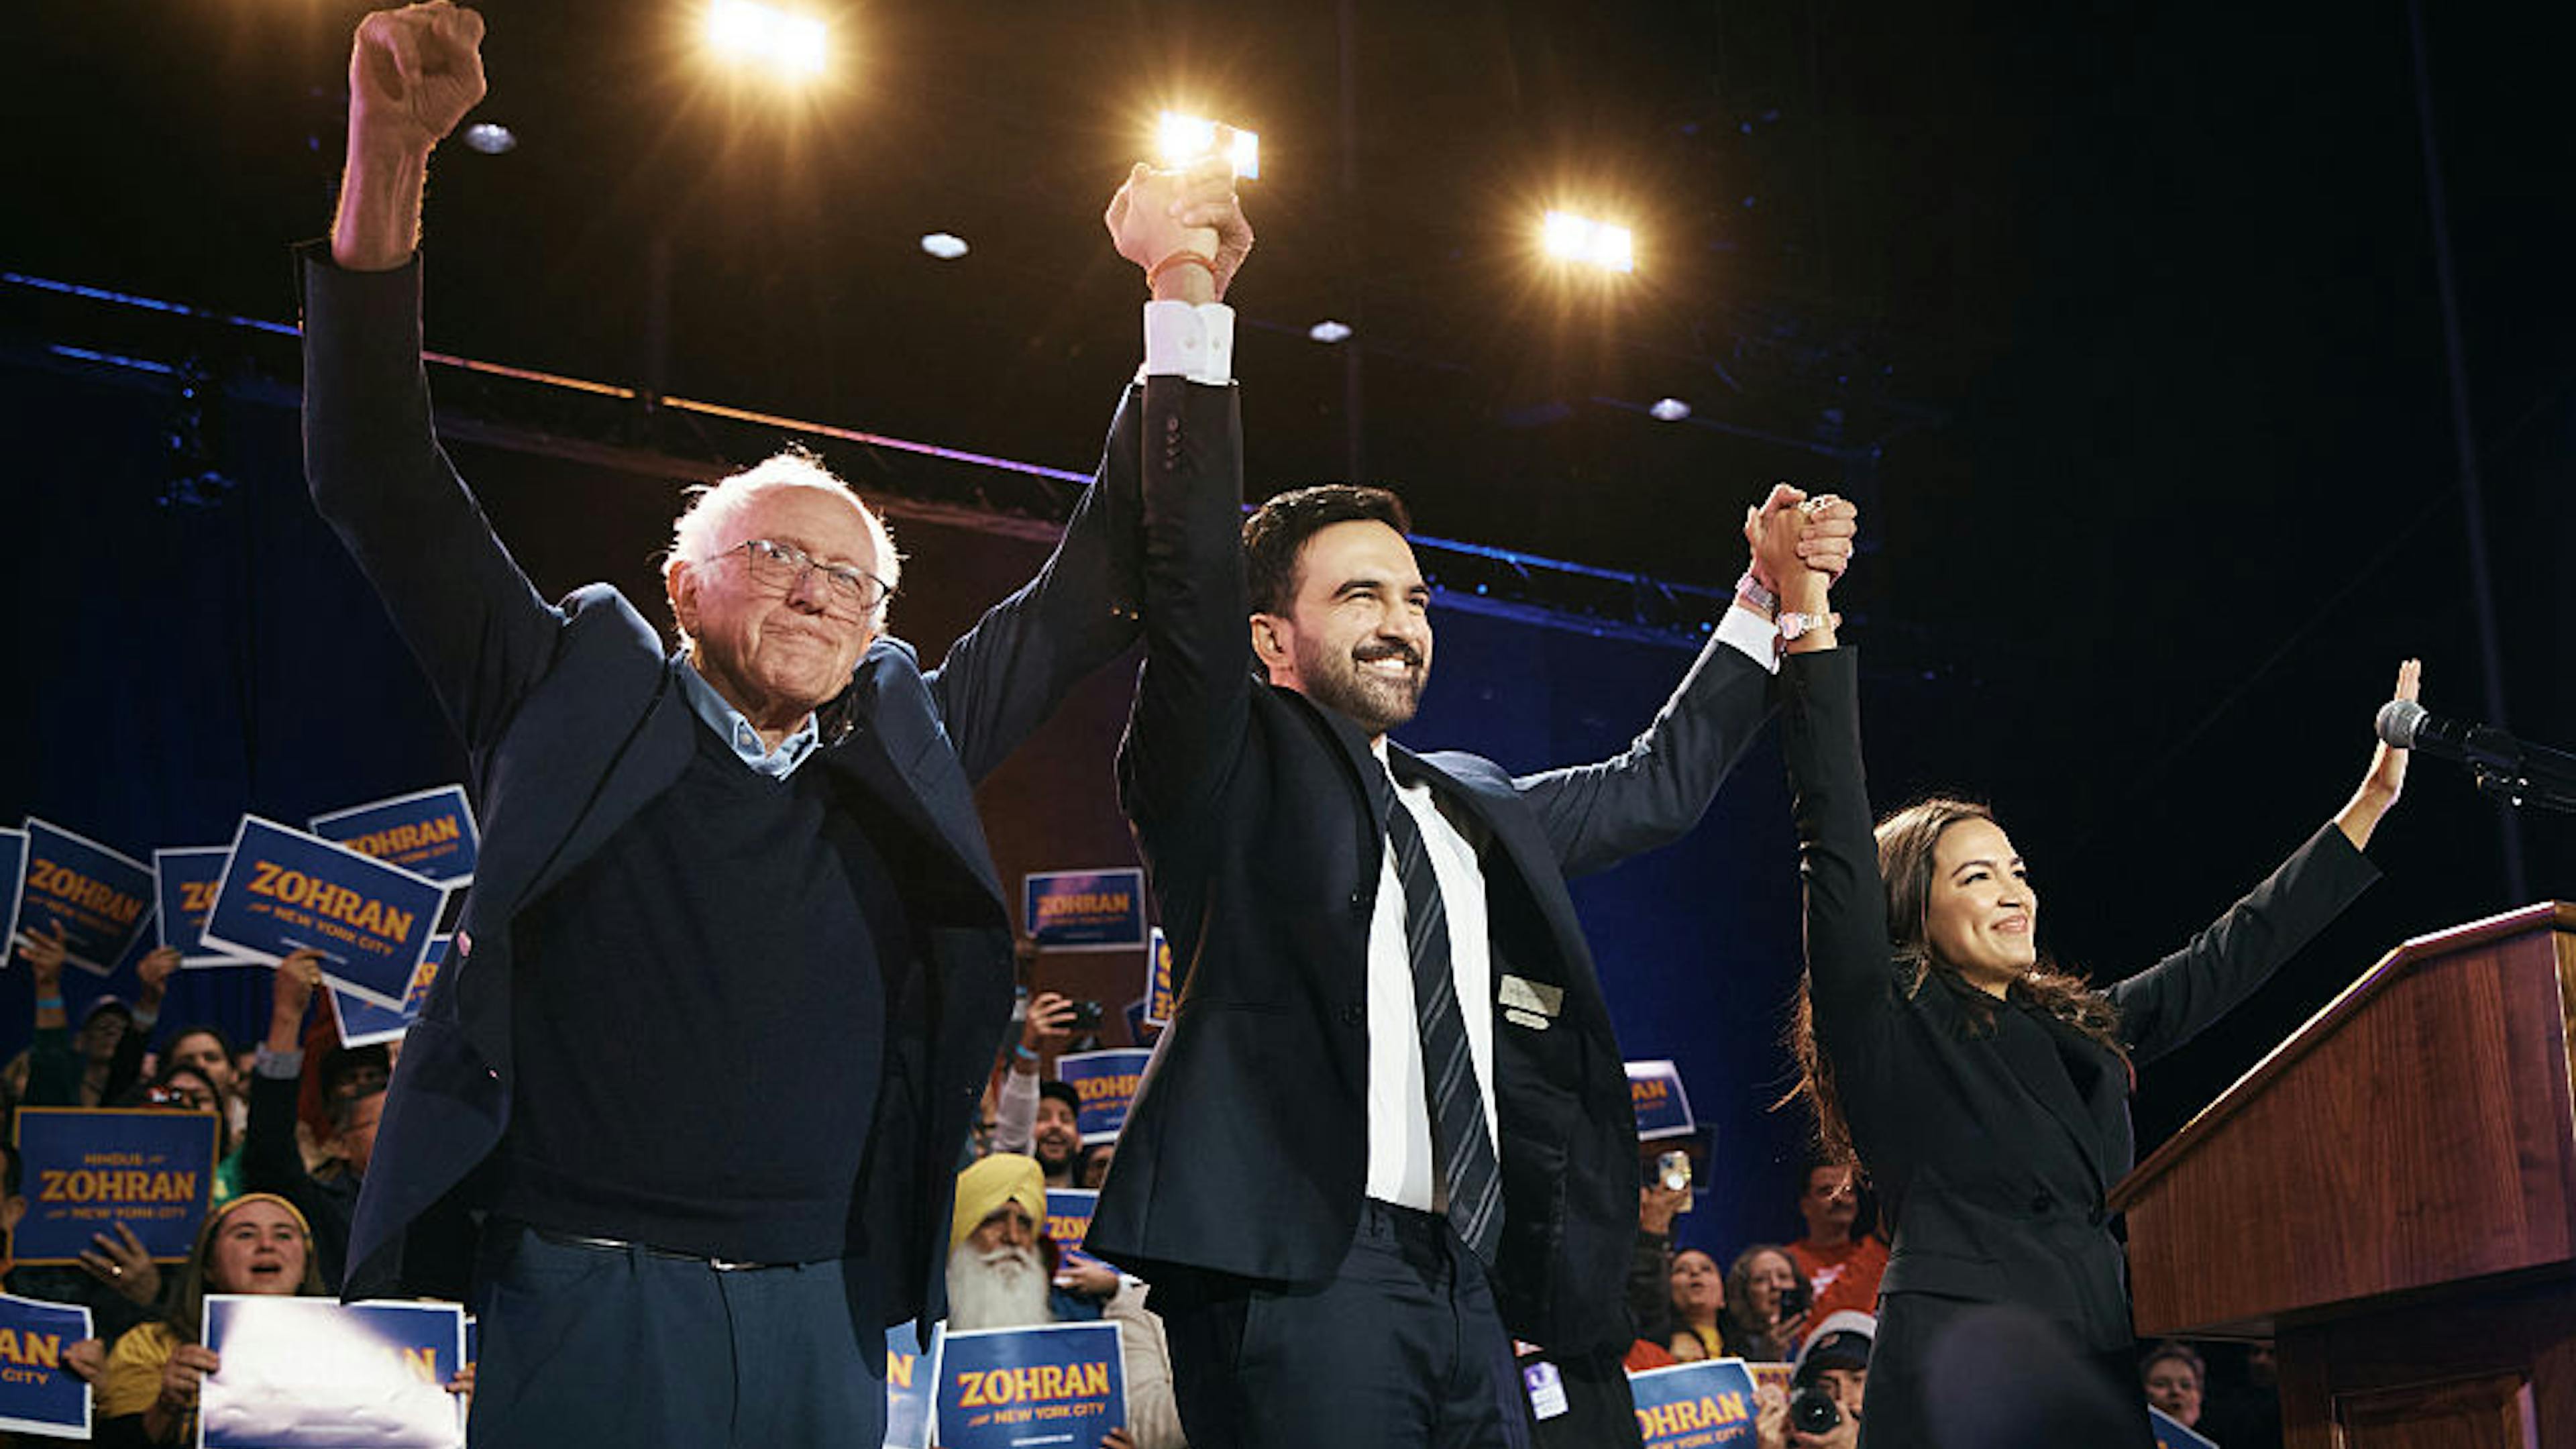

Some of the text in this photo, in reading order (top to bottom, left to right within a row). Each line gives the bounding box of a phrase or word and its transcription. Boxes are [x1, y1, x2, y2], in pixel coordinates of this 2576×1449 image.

[28, 859, 143, 922] ZOHRAN
[247, 861, 415, 943] ZOHRAN
[1037, 893, 1129, 917] ZOHRAN
[274, 907, 311, 928] NEW
[317, 920, 358, 943] YORK
[359, 937, 394, 955] CITY
[40, 1169, 196, 1202] ZOHRAN
[2, 1368, 49, 1385] CITY
[957, 1362, 1111, 1408] ZOHRAN
[994, 1402, 1106, 1425] NEW YORK CITY
